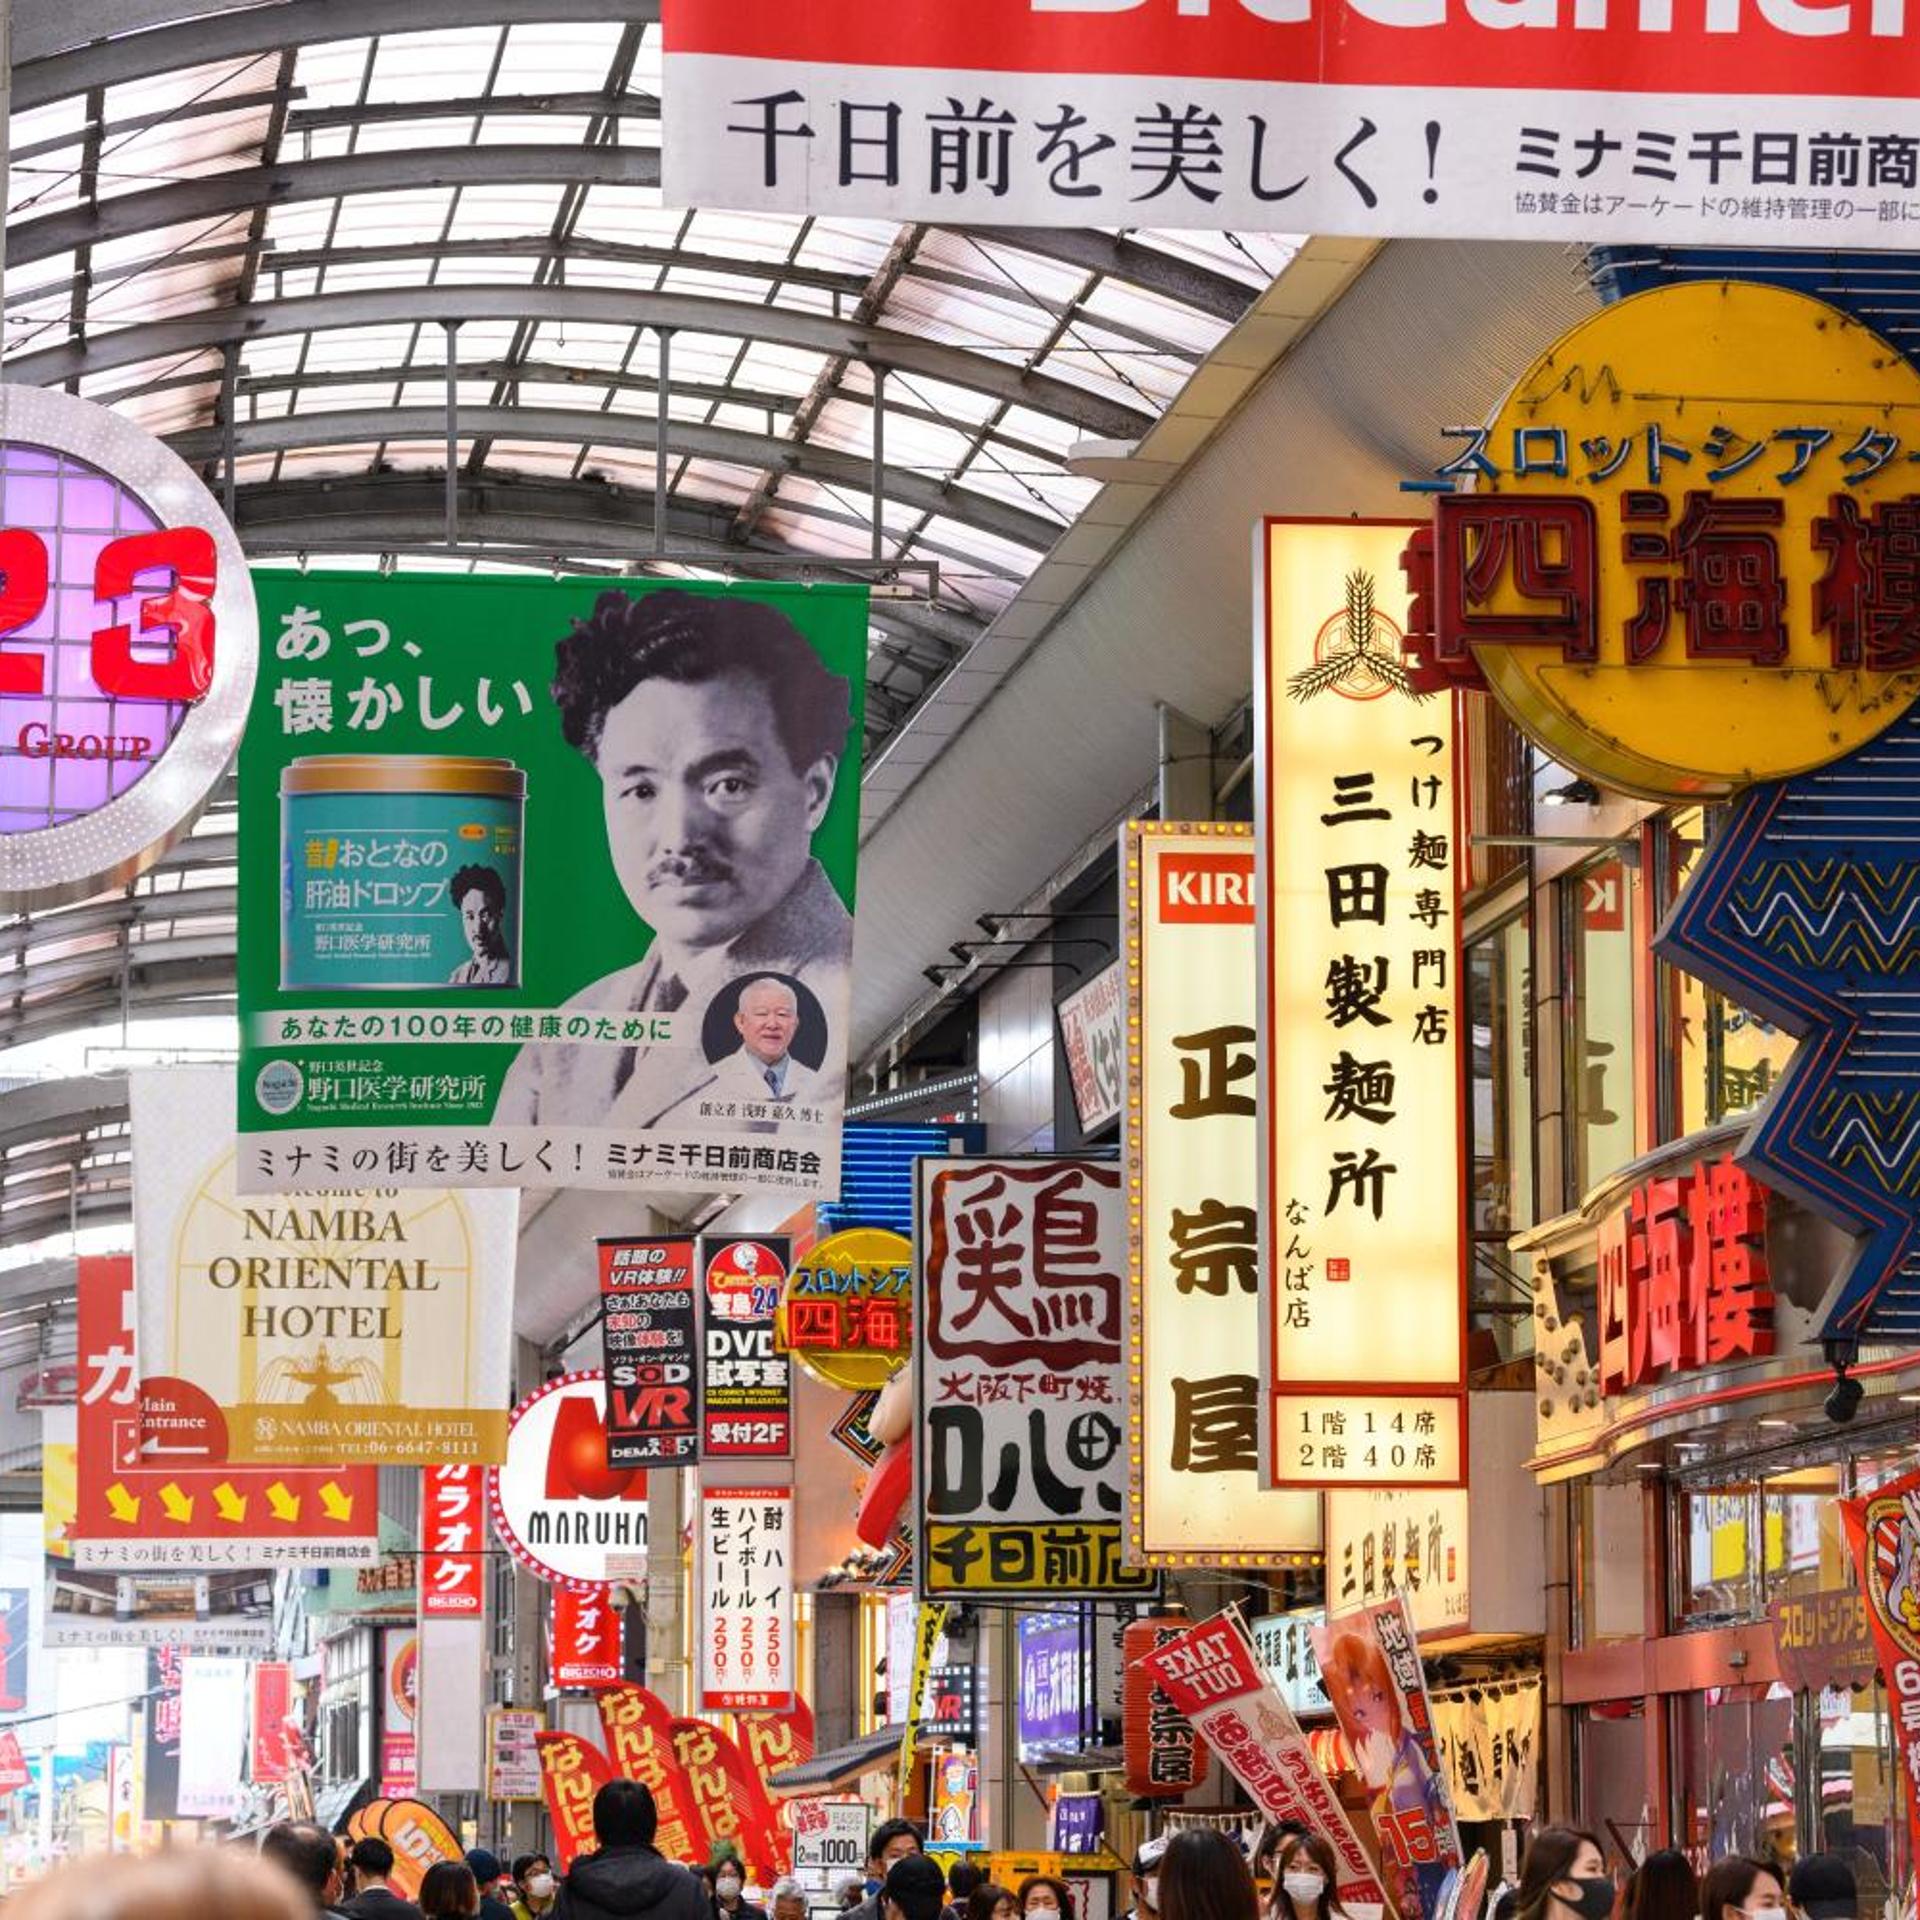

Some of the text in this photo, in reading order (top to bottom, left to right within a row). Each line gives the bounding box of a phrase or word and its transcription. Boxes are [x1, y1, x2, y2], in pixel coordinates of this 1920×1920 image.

[727, 90, 1442, 209] 千日前を美しく！
[1436, 423, 1920, 487] スロットシアタ
[273, 675, 534, 736] 懐かしい
[338, 838, 449, 869] おとなの
[305, 877, 450, 911] 肝油ドロップ
[1407, 734, 1451, 1046] つけ麺専門店
[1320, 771, 1398, 1222] 三田製麺所
[281, 1013, 672, 1041] あなたの100年の健康のために
[307, 1073, 488, 1102] 野口医学研究所
[257, 1138, 582, 1177] ミナミの街を美しく！
[607, 1143, 821, 1176] ミナミ千日前商店会
[243, 1208, 407, 1242] NAMBA
[1166, 1022, 1259, 1475] 正宗屋
[1283, 1198, 1313, 1330] なんば店
[208, 1256, 440, 1292] ORIENTAL
[241, 1305, 403, 1340] HOTEL
[788, 1297, 912, 1350] 四海
[612, 1363, 691, 1387] SOD
[139, 1416, 207, 1429] ntrance
[611, 1386, 692, 1428] VR
[281, 1420, 478, 1437] NAMBA ORIENTAL HOTEL
[710, 1423, 785, 1445] 受付2F
[710, 1506, 731, 1609] 生ビール
[737, 1506, 758, 1609] ハイボール
[763, 1506, 783, 1609] 酎ハイ
